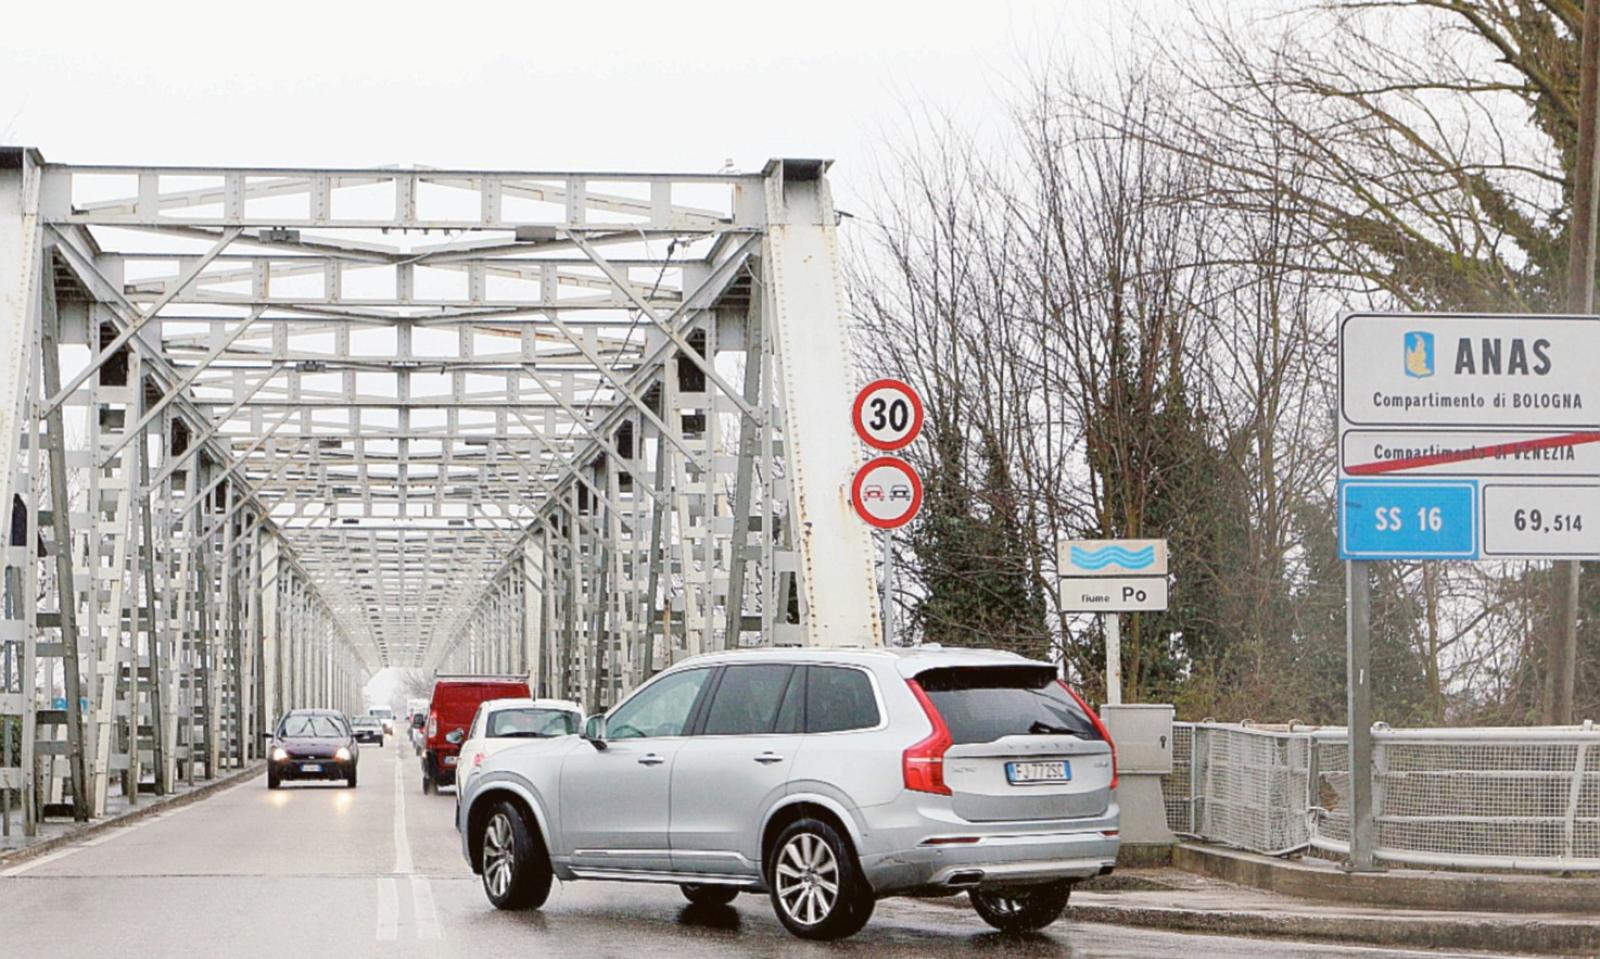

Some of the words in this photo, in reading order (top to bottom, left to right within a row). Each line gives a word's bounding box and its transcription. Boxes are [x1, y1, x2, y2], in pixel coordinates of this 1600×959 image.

[1454, 338, 1551, 376] ANAS
[1373, 392, 1485, 411] Compartimento
[1493, 393, 1506, 408] di
[1513, 393, 1583, 409] BOLOGNA
[869, 398, 908, 432] 30
[1514, 444, 1575, 461] VENEZIA
[1375, 507, 1402, 531] SS
[1417, 507, 1442, 531] 16
[1514, 509, 1583, 534] 69,514
[1081, 594, 1110, 603] fiume
[1122, 586, 1147, 602] Po
